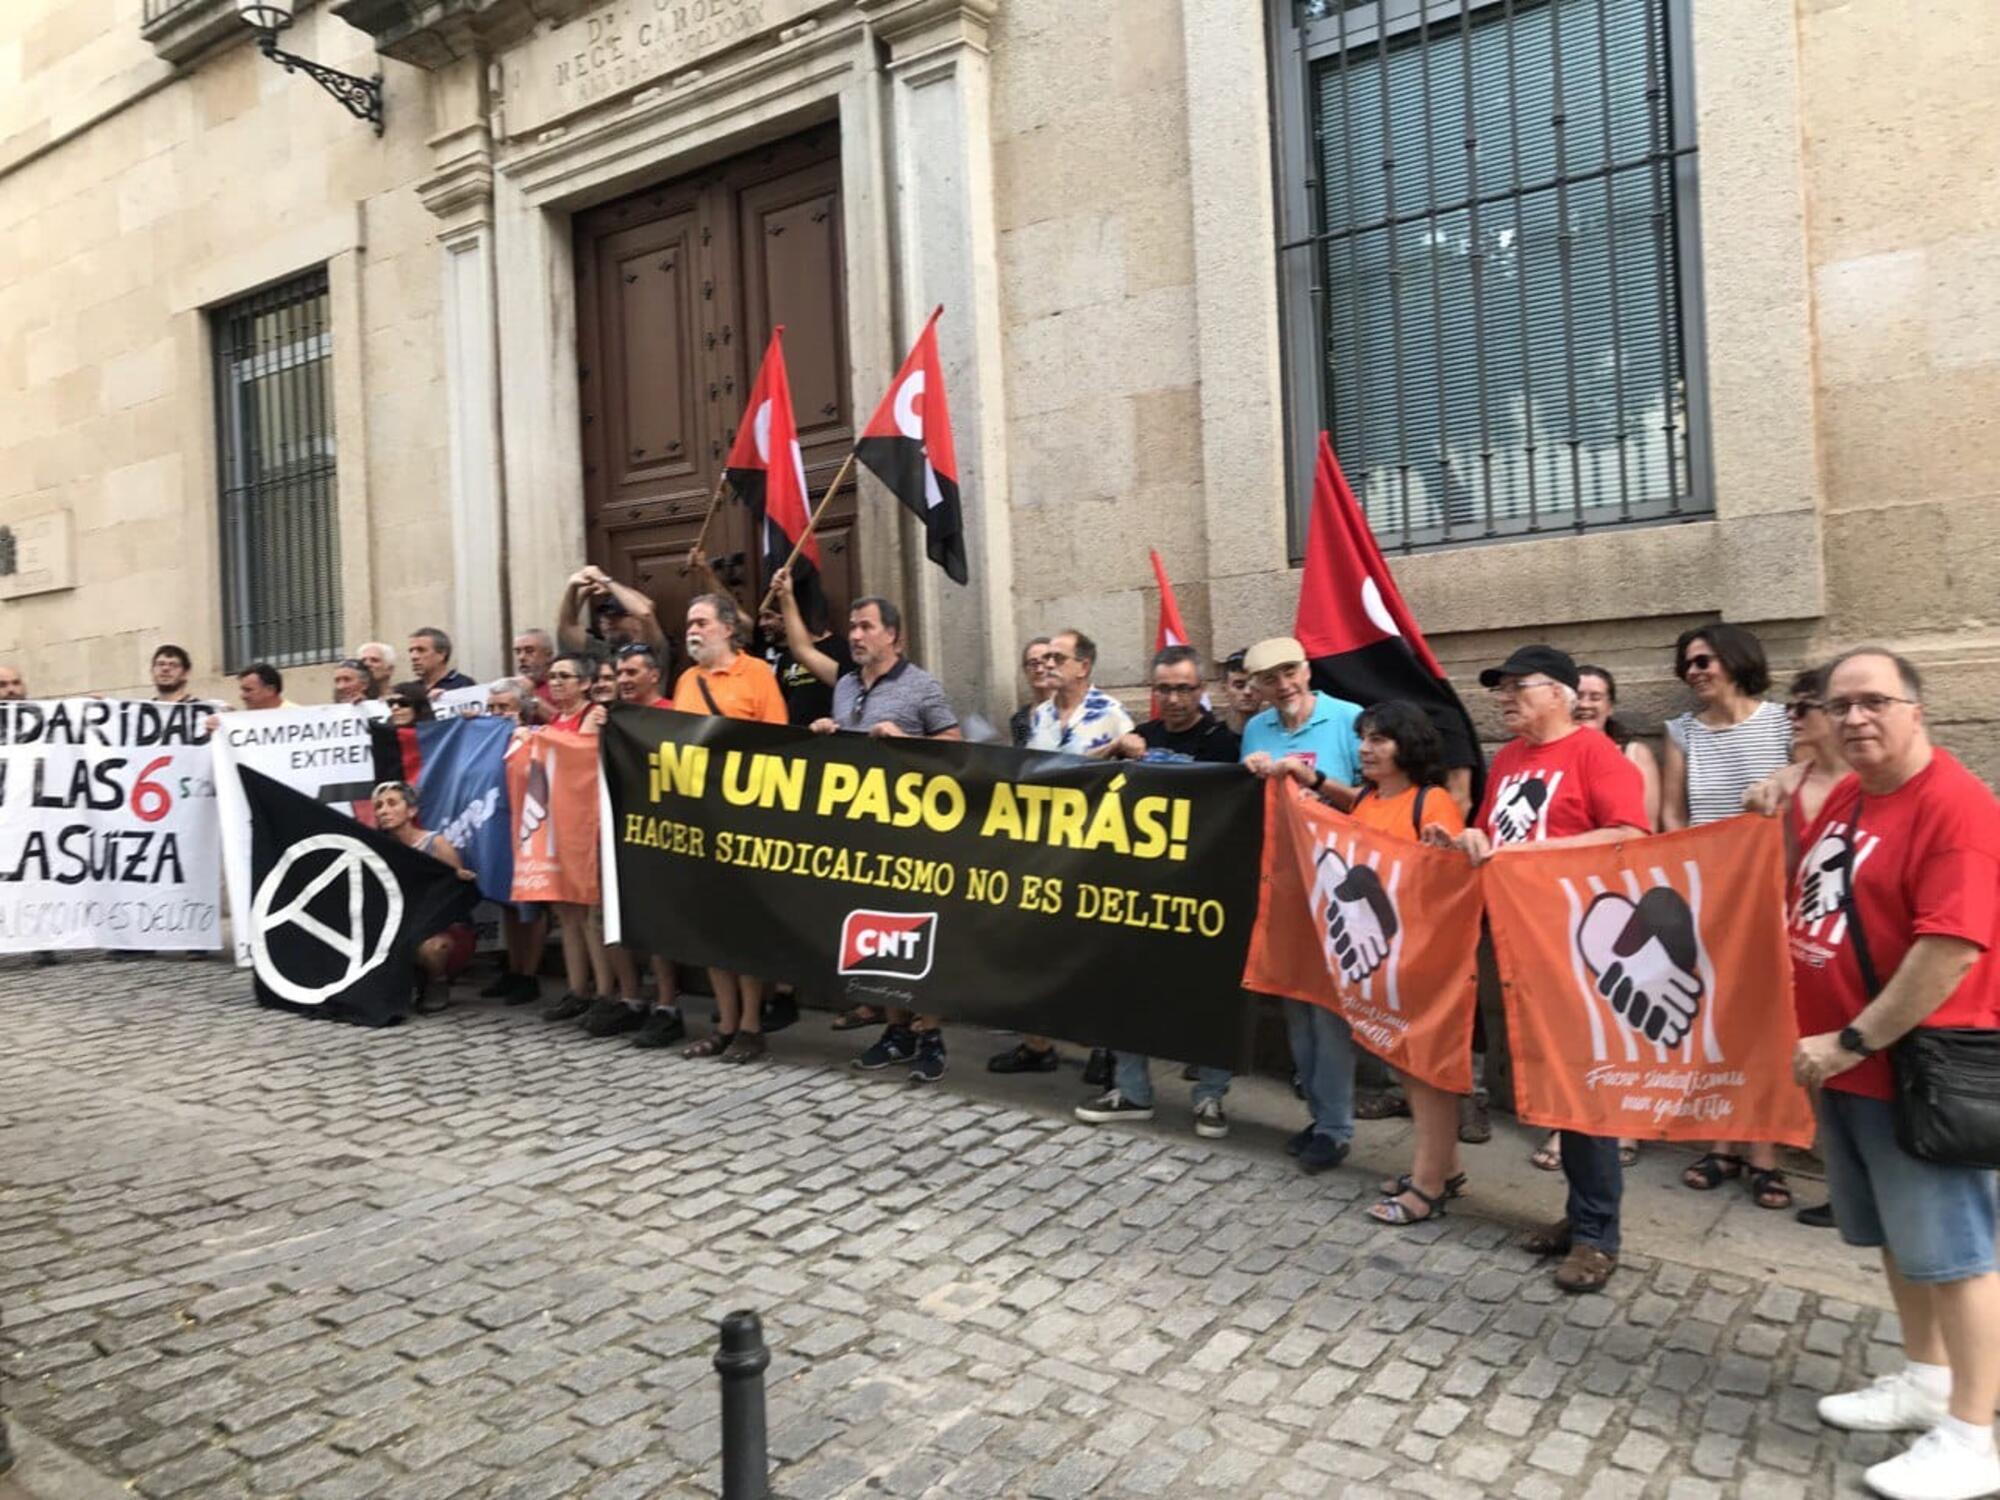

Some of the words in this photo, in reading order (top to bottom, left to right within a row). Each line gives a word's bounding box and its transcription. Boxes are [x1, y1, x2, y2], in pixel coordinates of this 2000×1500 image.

[31, 758, 127, 810] LAS
[130, 756, 174, 822] 6
[649, 741, 709, 803] ¡NI
[722, 751, 807, 812] UN
[816, 762, 967, 833] PASO
[980, 773, 1191, 861] ATRÁS!
[624, 814, 705, 858] HACER
[715, 832, 955, 897] SINDICALISMO
[965, 867, 1010, 905] NO
[1018, 875, 1063, 914] ES
[1076, 884, 1225, 938] DELITO
[856, 928, 921, 960] CNT
